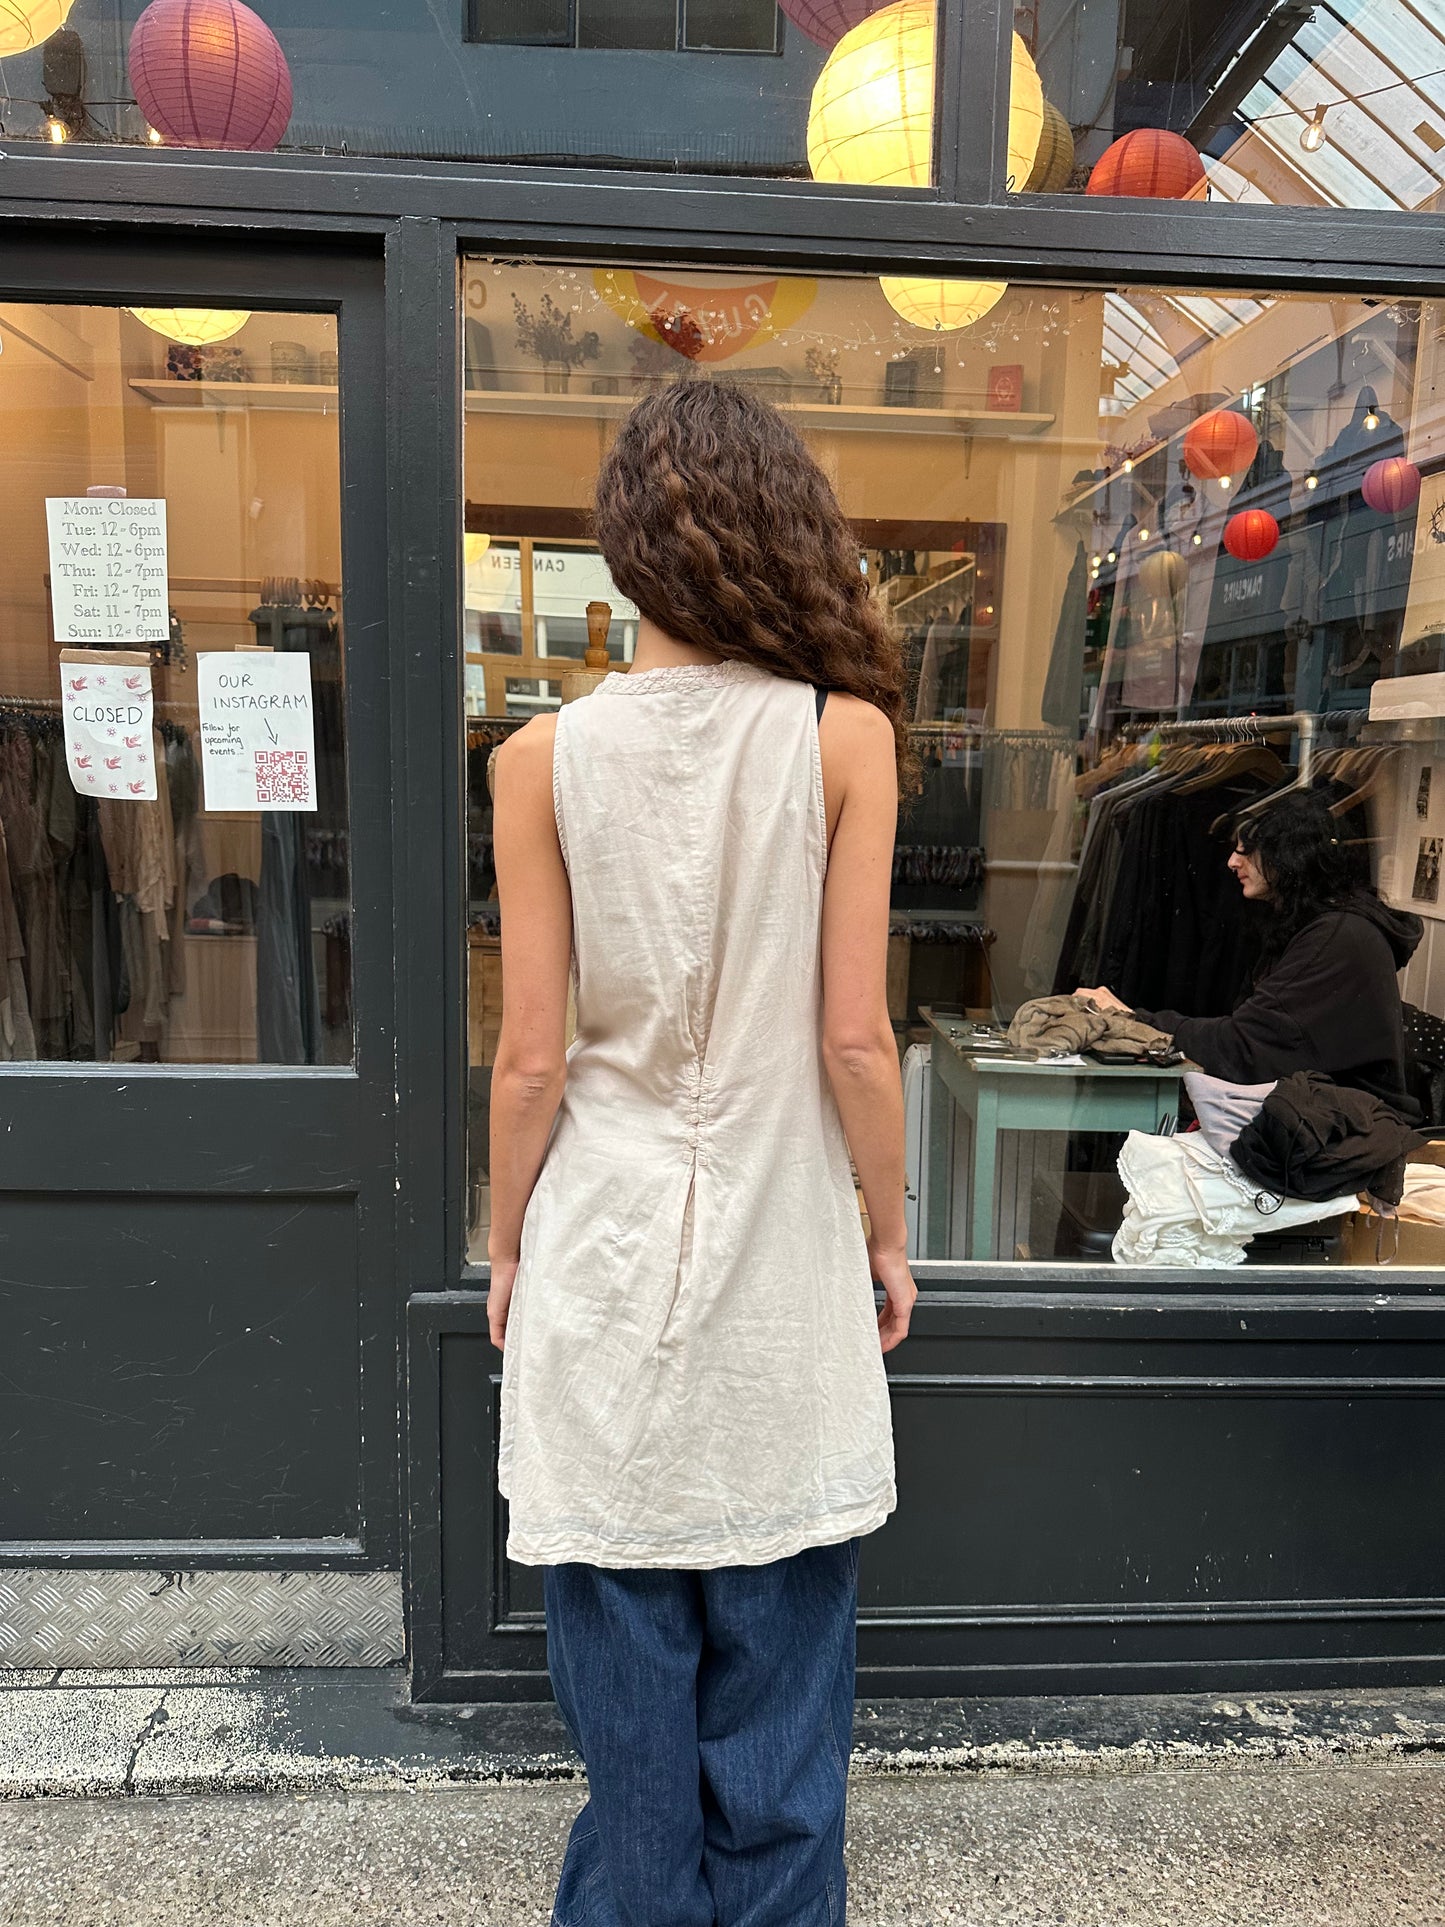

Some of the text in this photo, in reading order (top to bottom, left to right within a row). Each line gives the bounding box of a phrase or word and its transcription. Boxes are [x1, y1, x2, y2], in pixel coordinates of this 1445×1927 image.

[64, 501, 157, 516] Mon: Closed
[62, 522, 96, 536] Tue:
[60, 542, 101, 556] Wed:
[58, 563, 96, 576] Thu:
[72, 584, 98, 597] Fri:
[74, 604, 100, 617] Sat:
[68, 624, 102, 637] Sun:
[219, 674, 253, 688] OUR
[213, 694, 308, 709] INSTAGRAM
[73, 706, 142, 725] CLOSED
[202, 722, 240, 737] Follow for
[205, 737, 244, 750] upcoming
